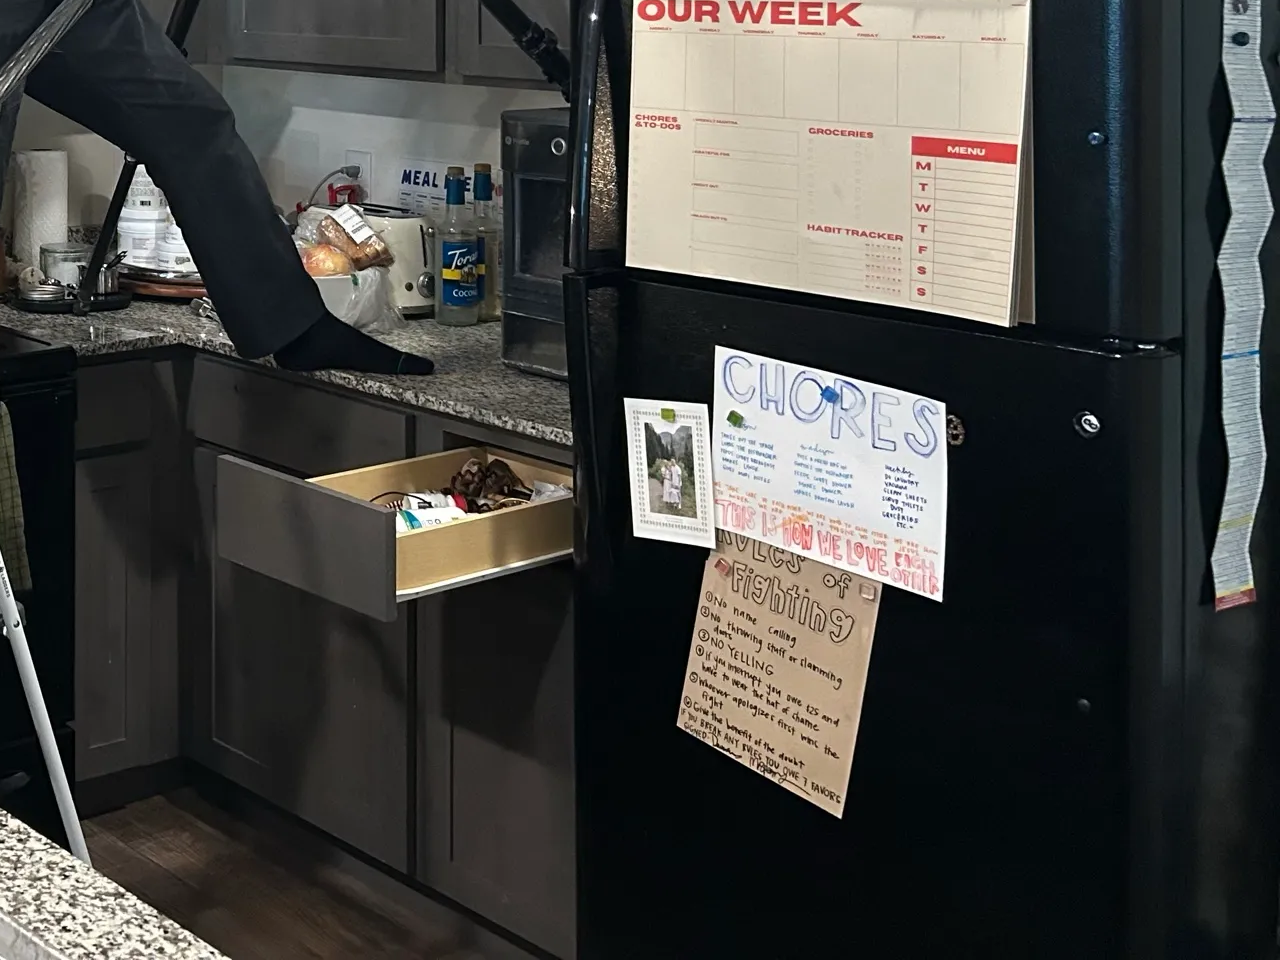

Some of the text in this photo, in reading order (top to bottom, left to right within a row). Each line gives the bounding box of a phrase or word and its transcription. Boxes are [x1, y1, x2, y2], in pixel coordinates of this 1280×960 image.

[727, 0, 863, 27] WEEK
[635, 114, 678, 122] CHORES
[809, 128, 874, 138] GROCERIES
[947, 146, 985, 156] MENU
[916, 162, 931, 170] M
[401, 169, 438, 188] MEAL
[919, 183, 928, 191] T
[915, 204, 931, 212] W
[807, 224, 903, 241] HABIT TRACKER
[918, 225, 927, 233] T
[919, 246, 927, 254] F
[917, 266, 926, 275] S
[917, 287, 926, 296] S
[723, 355, 940, 458] CHORES
[890, 504, 903, 513] DUST
[714, 499, 756, 531] THIS
[782, 517, 813, 551] HOW
[817, 530, 842, 561] WE
[846, 539, 889, 576] LOVE
[895, 552, 935, 575] EACH
[822, 572, 852, 599] of
[890, 568, 939, 595] OTHER
[714, 598, 727, 608] No
[733, 604, 757, 625] name
[731, 561, 855, 644] Fighting
[711, 637, 724, 649] NO
[728, 644, 774, 675] YELLING
[727, 621, 763, 653] throwing
[767, 642, 786, 659] stuff
[789, 653, 798, 663] or
[800, 658, 843, 690] slamming
[702, 691, 724, 710] fight
[722, 671, 730, 682] to
[732, 678, 748, 691] wear
[752, 688, 764, 700] the
[766, 698, 779, 710] hat
[792, 711, 820, 732] shame
[766, 683, 781, 697] you
[786, 694, 801, 706] owe
[821, 713, 840, 727] and
[700, 717, 722, 737] BREAK
[724, 734, 740, 749] ANY
[742, 742, 762, 761] RULES
[782, 767, 800, 780] OWE
[778, 719, 795, 736] first
[824, 745, 840, 760] the
[763, 741, 775, 754] the
[779, 752, 805, 769] doubt
